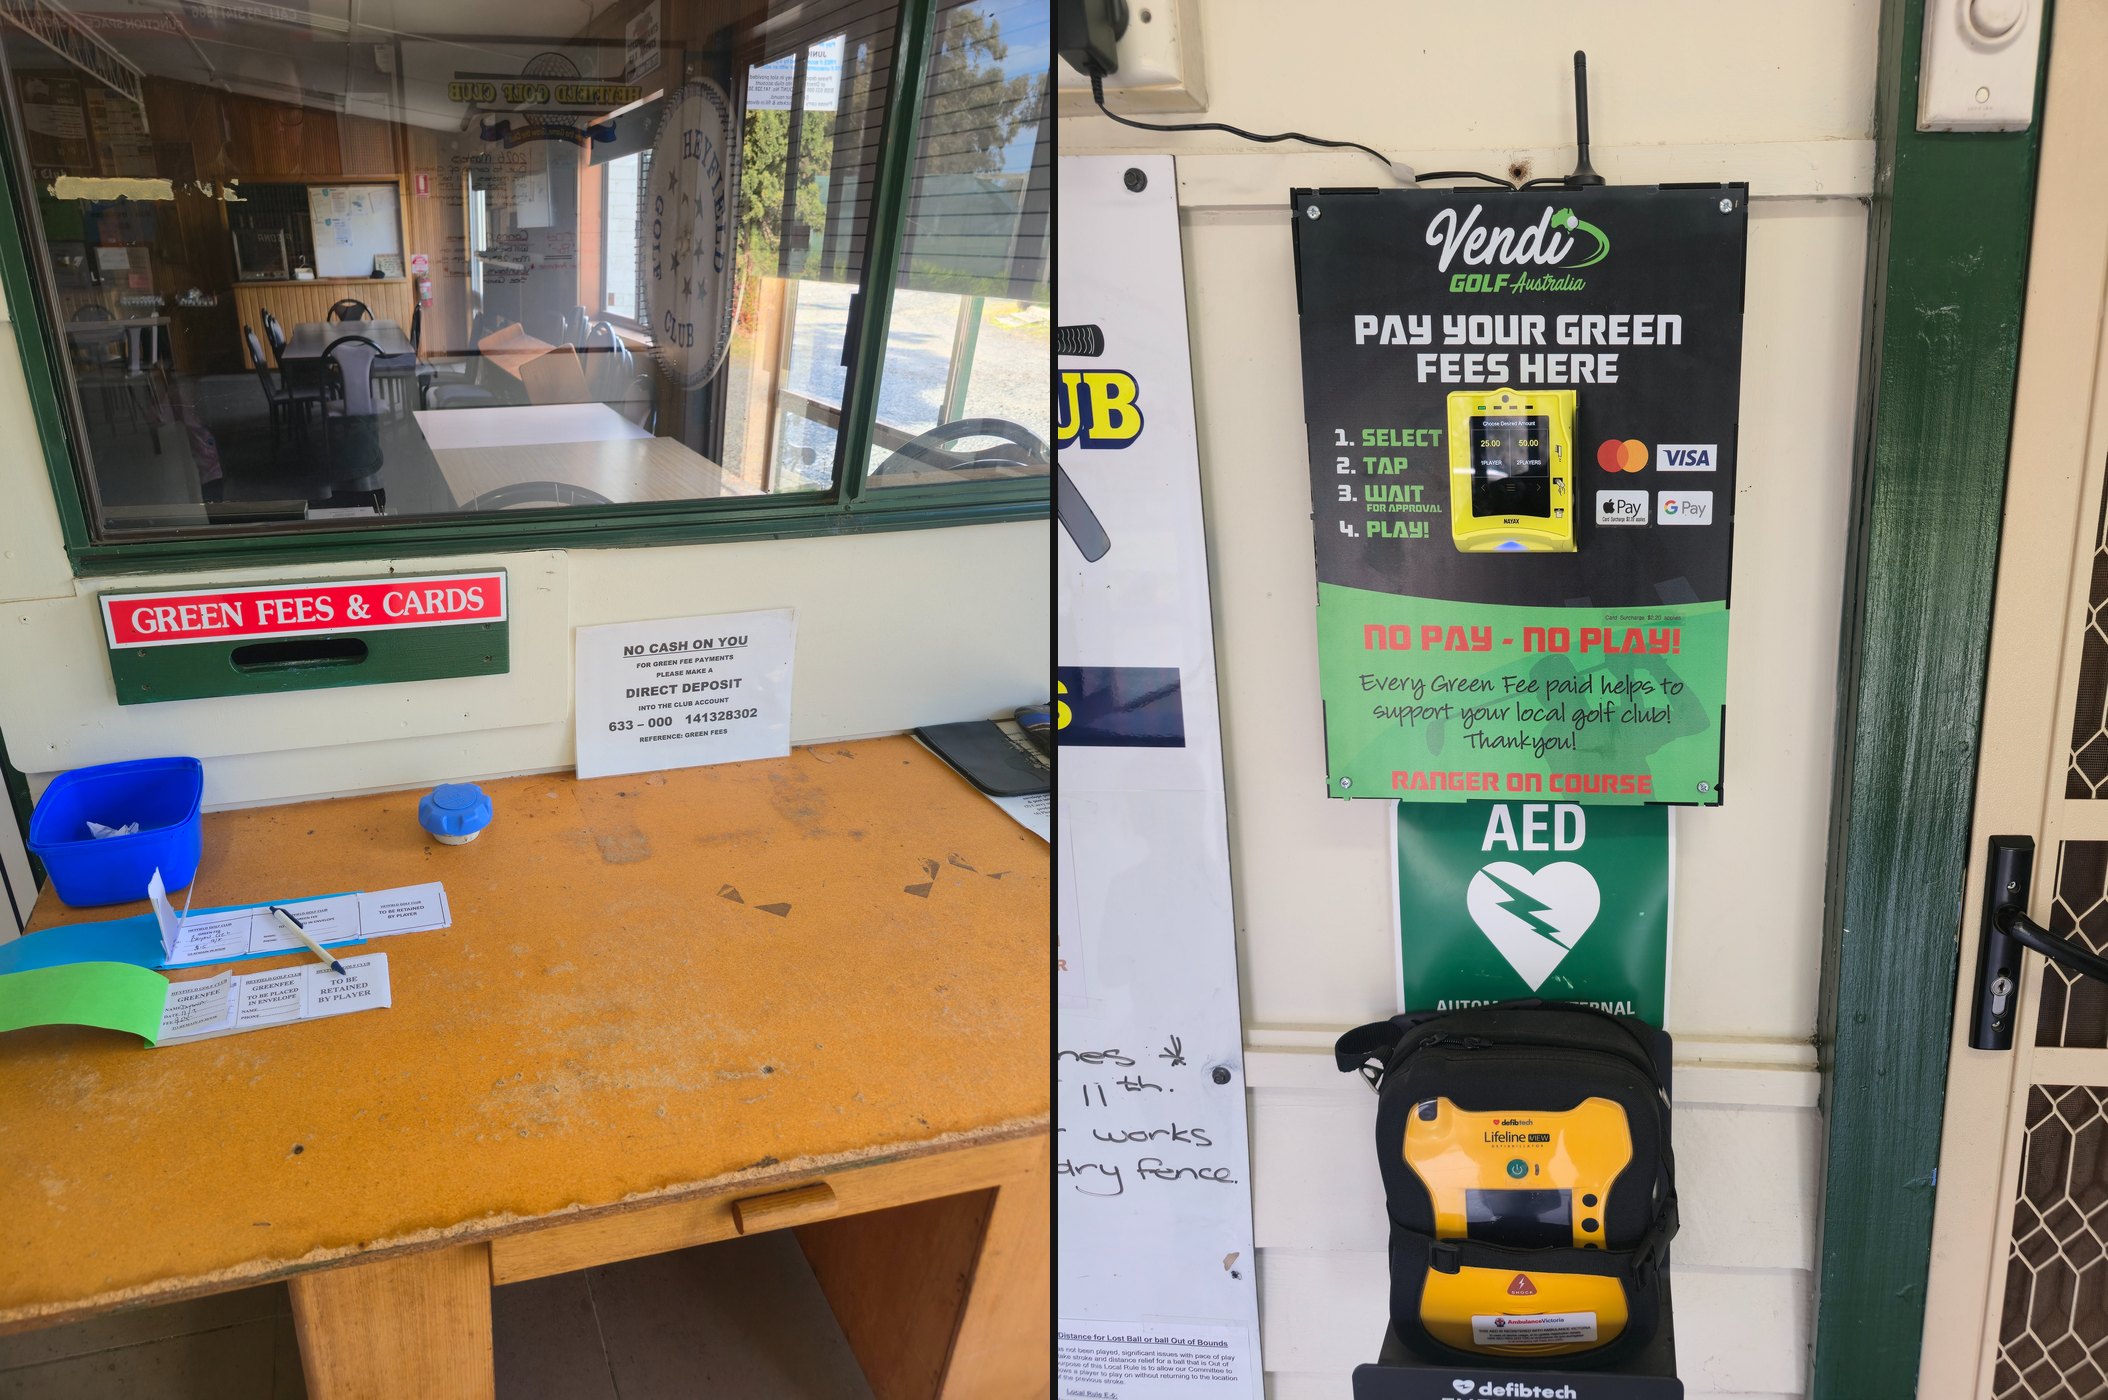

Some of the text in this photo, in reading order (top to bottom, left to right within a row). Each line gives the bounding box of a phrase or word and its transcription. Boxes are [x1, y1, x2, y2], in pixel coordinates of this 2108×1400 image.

[683, 129, 727, 274] HEYFIELD
[652, 195, 664, 281] GOLF
[1425, 203, 1575, 273] Vendi
[1449, 271, 1586, 295] GOLF Australia
[664, 310, 694, 348] CLUB
[1354, 314, 1682, 345] PAY YOUR GREEN
[1417, 353, 1619, 384] FEES HERE
[1334, 428, 1443, 447] 1. SELECT
[1336, 457, 1408, 475] 2. TAP
[1662, 450, 1710, 466] VISA
[1337, 485, 1424, 502] 3. WAIT
[1366, 504, 1442, 513] FOR APPROVAL
[1617, 500, 1641, 517] Pay
[1682, 501, 1707, 518] Pay
[1339, 520, 1429, 538] 4. PLAY!
[131, 586, 485, 635] GREEN FEES & CARDS
[623, 635, 748, 656] NO CASH ON YOU
[1363, 624, 1411, 650] NO
[1420, 625, 1493, 652] PAY
[1523, 626, 1570, 653] NO
[1580, 627, 1681, 654] PLAY!
[636, 661, 651, 669] FOR
[653, 659, 678, 667] GREEN
[695, 654, 734, 663] PAYMENTS
[656, 670, 684, 678] PLEASE
[685, 668, 707, 676] MAKE
[626, 678, 743, 698] DIRECT DEPOSIT
[1359, 673, 1683, 701] Every Green Fee paid helps to
[638, 703, 656, 711] INTO
[674, 700, 693, 708] CLUB
[694, 697, 729, 706] ACCOUNT
[608, 720, 634, 732] 633
[648, 716, 673, 728] 000
[685, 708, 758, 725] 141328302
[1373, 701, 1671, 730] support your local golf club!
[639, 728, 728, 743] REFERENCE: GREEN FEES
[1463, 730, 1576, 758] Thankyou!
[1391, 770, 1653, 794] RANGER ON COURSE
[1481, 804, 1586, 852] AED
[252, 980, 295, 991] GREENFEE
[270, 987, 299, 996] PLACED
[320, 982, 368, 995] RETAINED
[177, 989, 221, 1003] GREENFEE
[258, 993, 297, 1005] ENVELOPE
[333, 989, 371, 1001] PLAYER
[1093, 1122, 1212, 1147] works
[1484, 1130, 1549, 1143] Lifeline VIEW
[1058, 1331, 1092, 1340] Distance
[1197, 1339, 1228, 1347] Bounds
[1121, 1349, 1156, 1357] significant
[1478, 1381, 1576, 1399] defibtech
